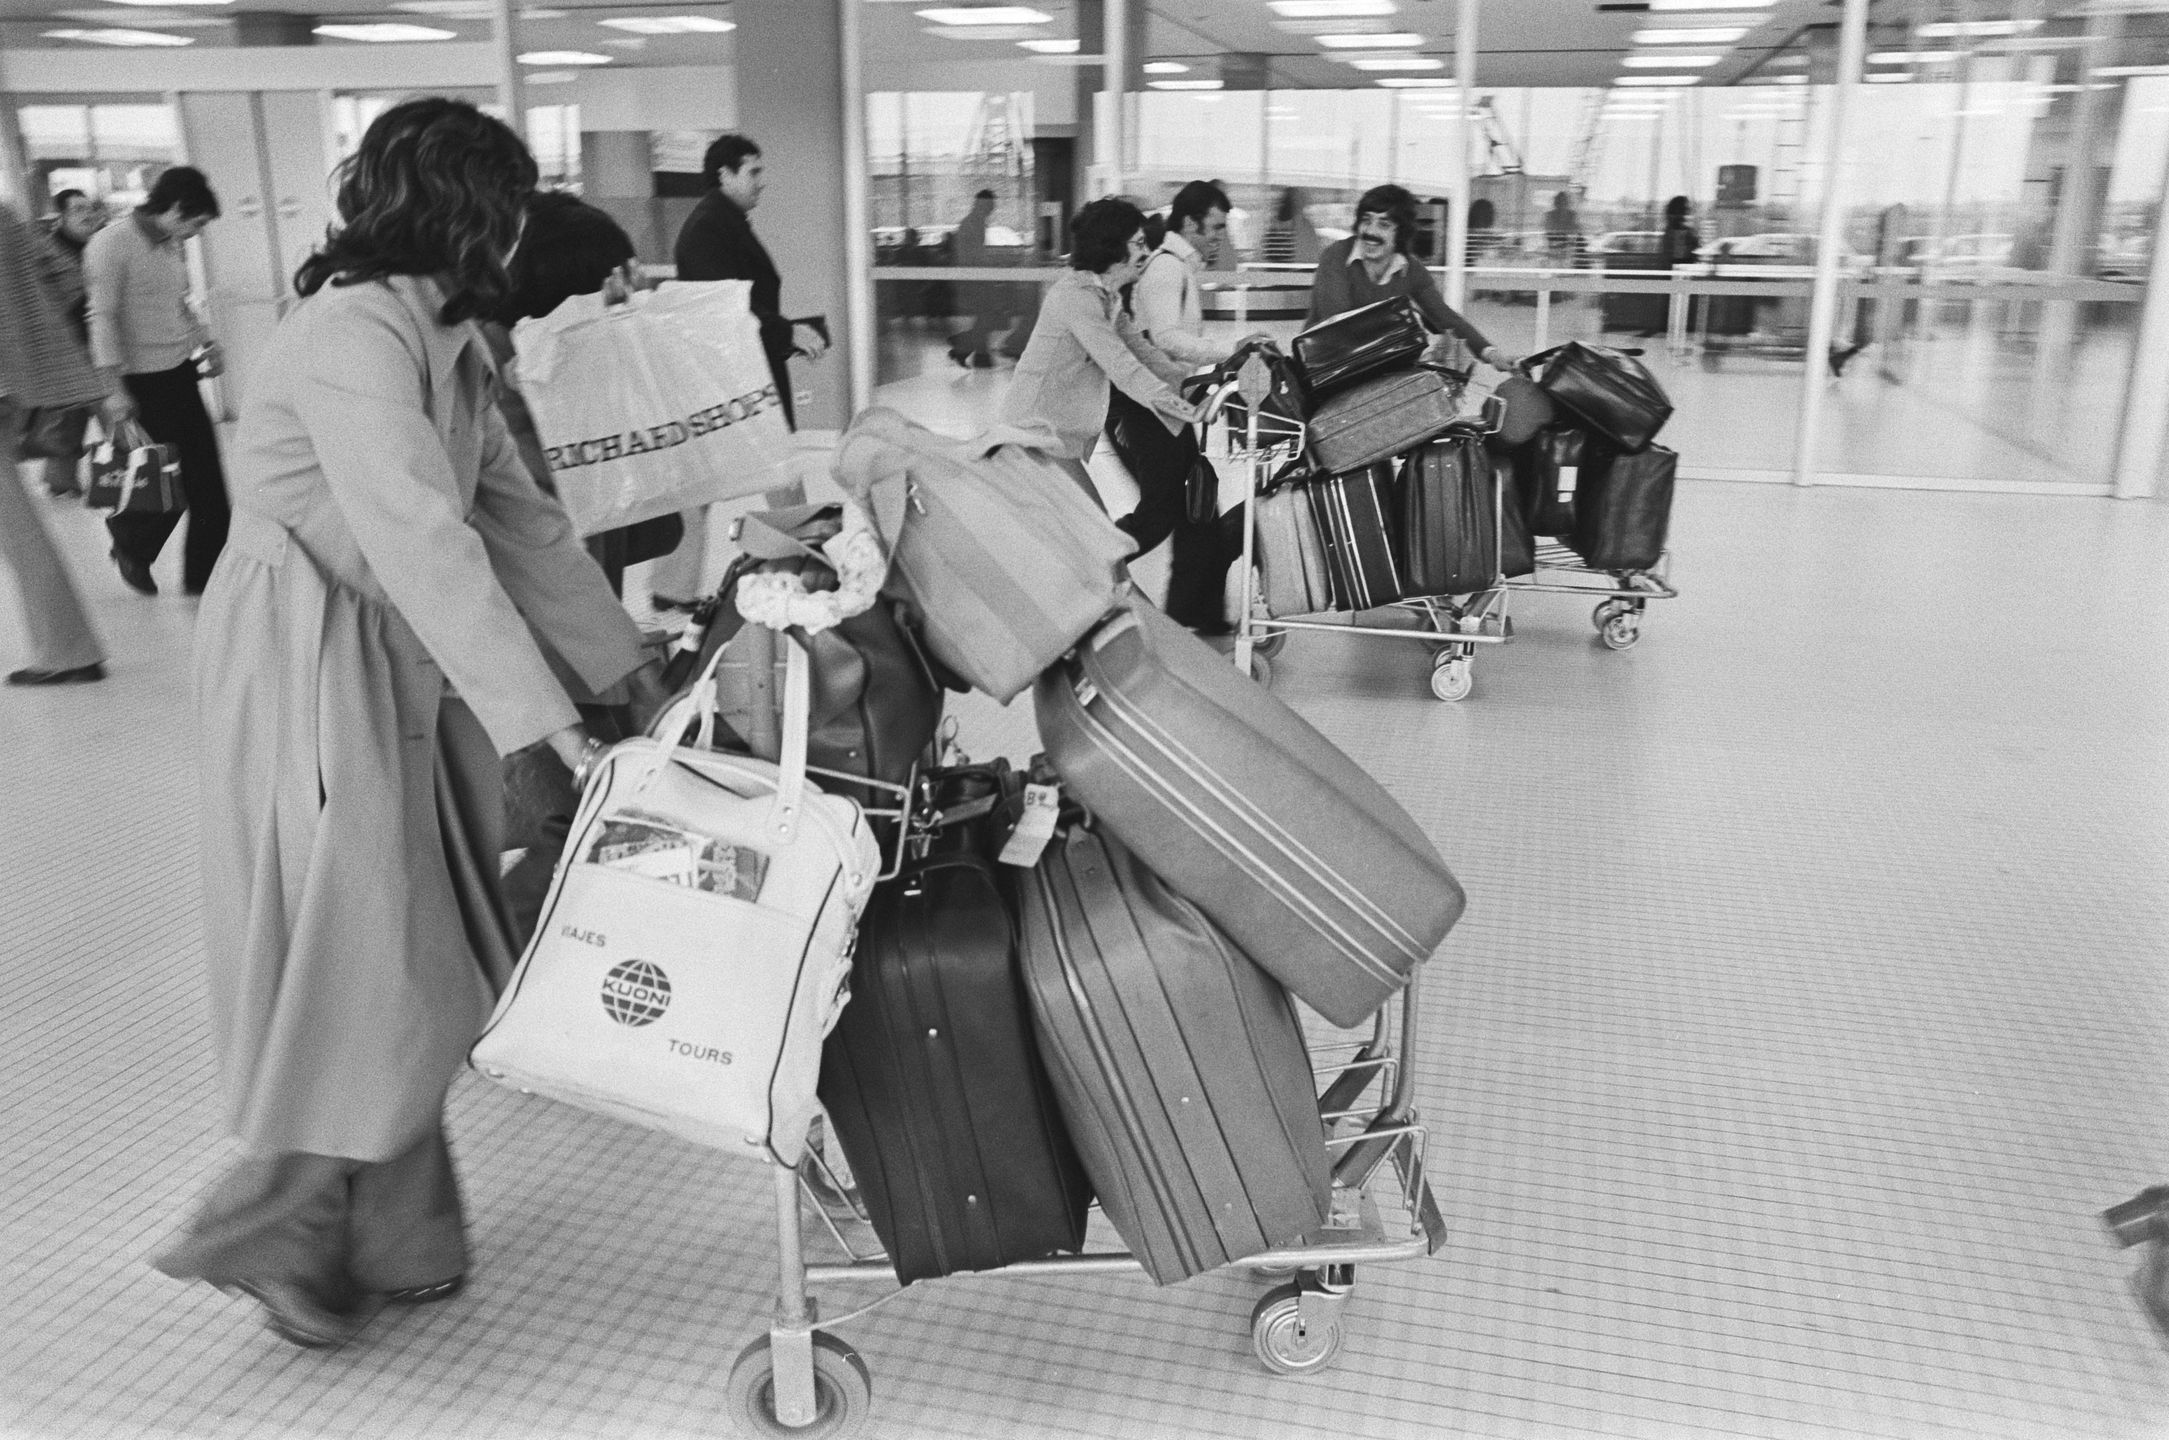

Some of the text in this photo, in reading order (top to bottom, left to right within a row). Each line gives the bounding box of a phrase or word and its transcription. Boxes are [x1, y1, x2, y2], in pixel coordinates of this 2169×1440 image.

[543, 421, 688, 472] RICHARD
[602, 979, 671, 1007] KUONI
[669, 1039, 733, 1065] TOURS
